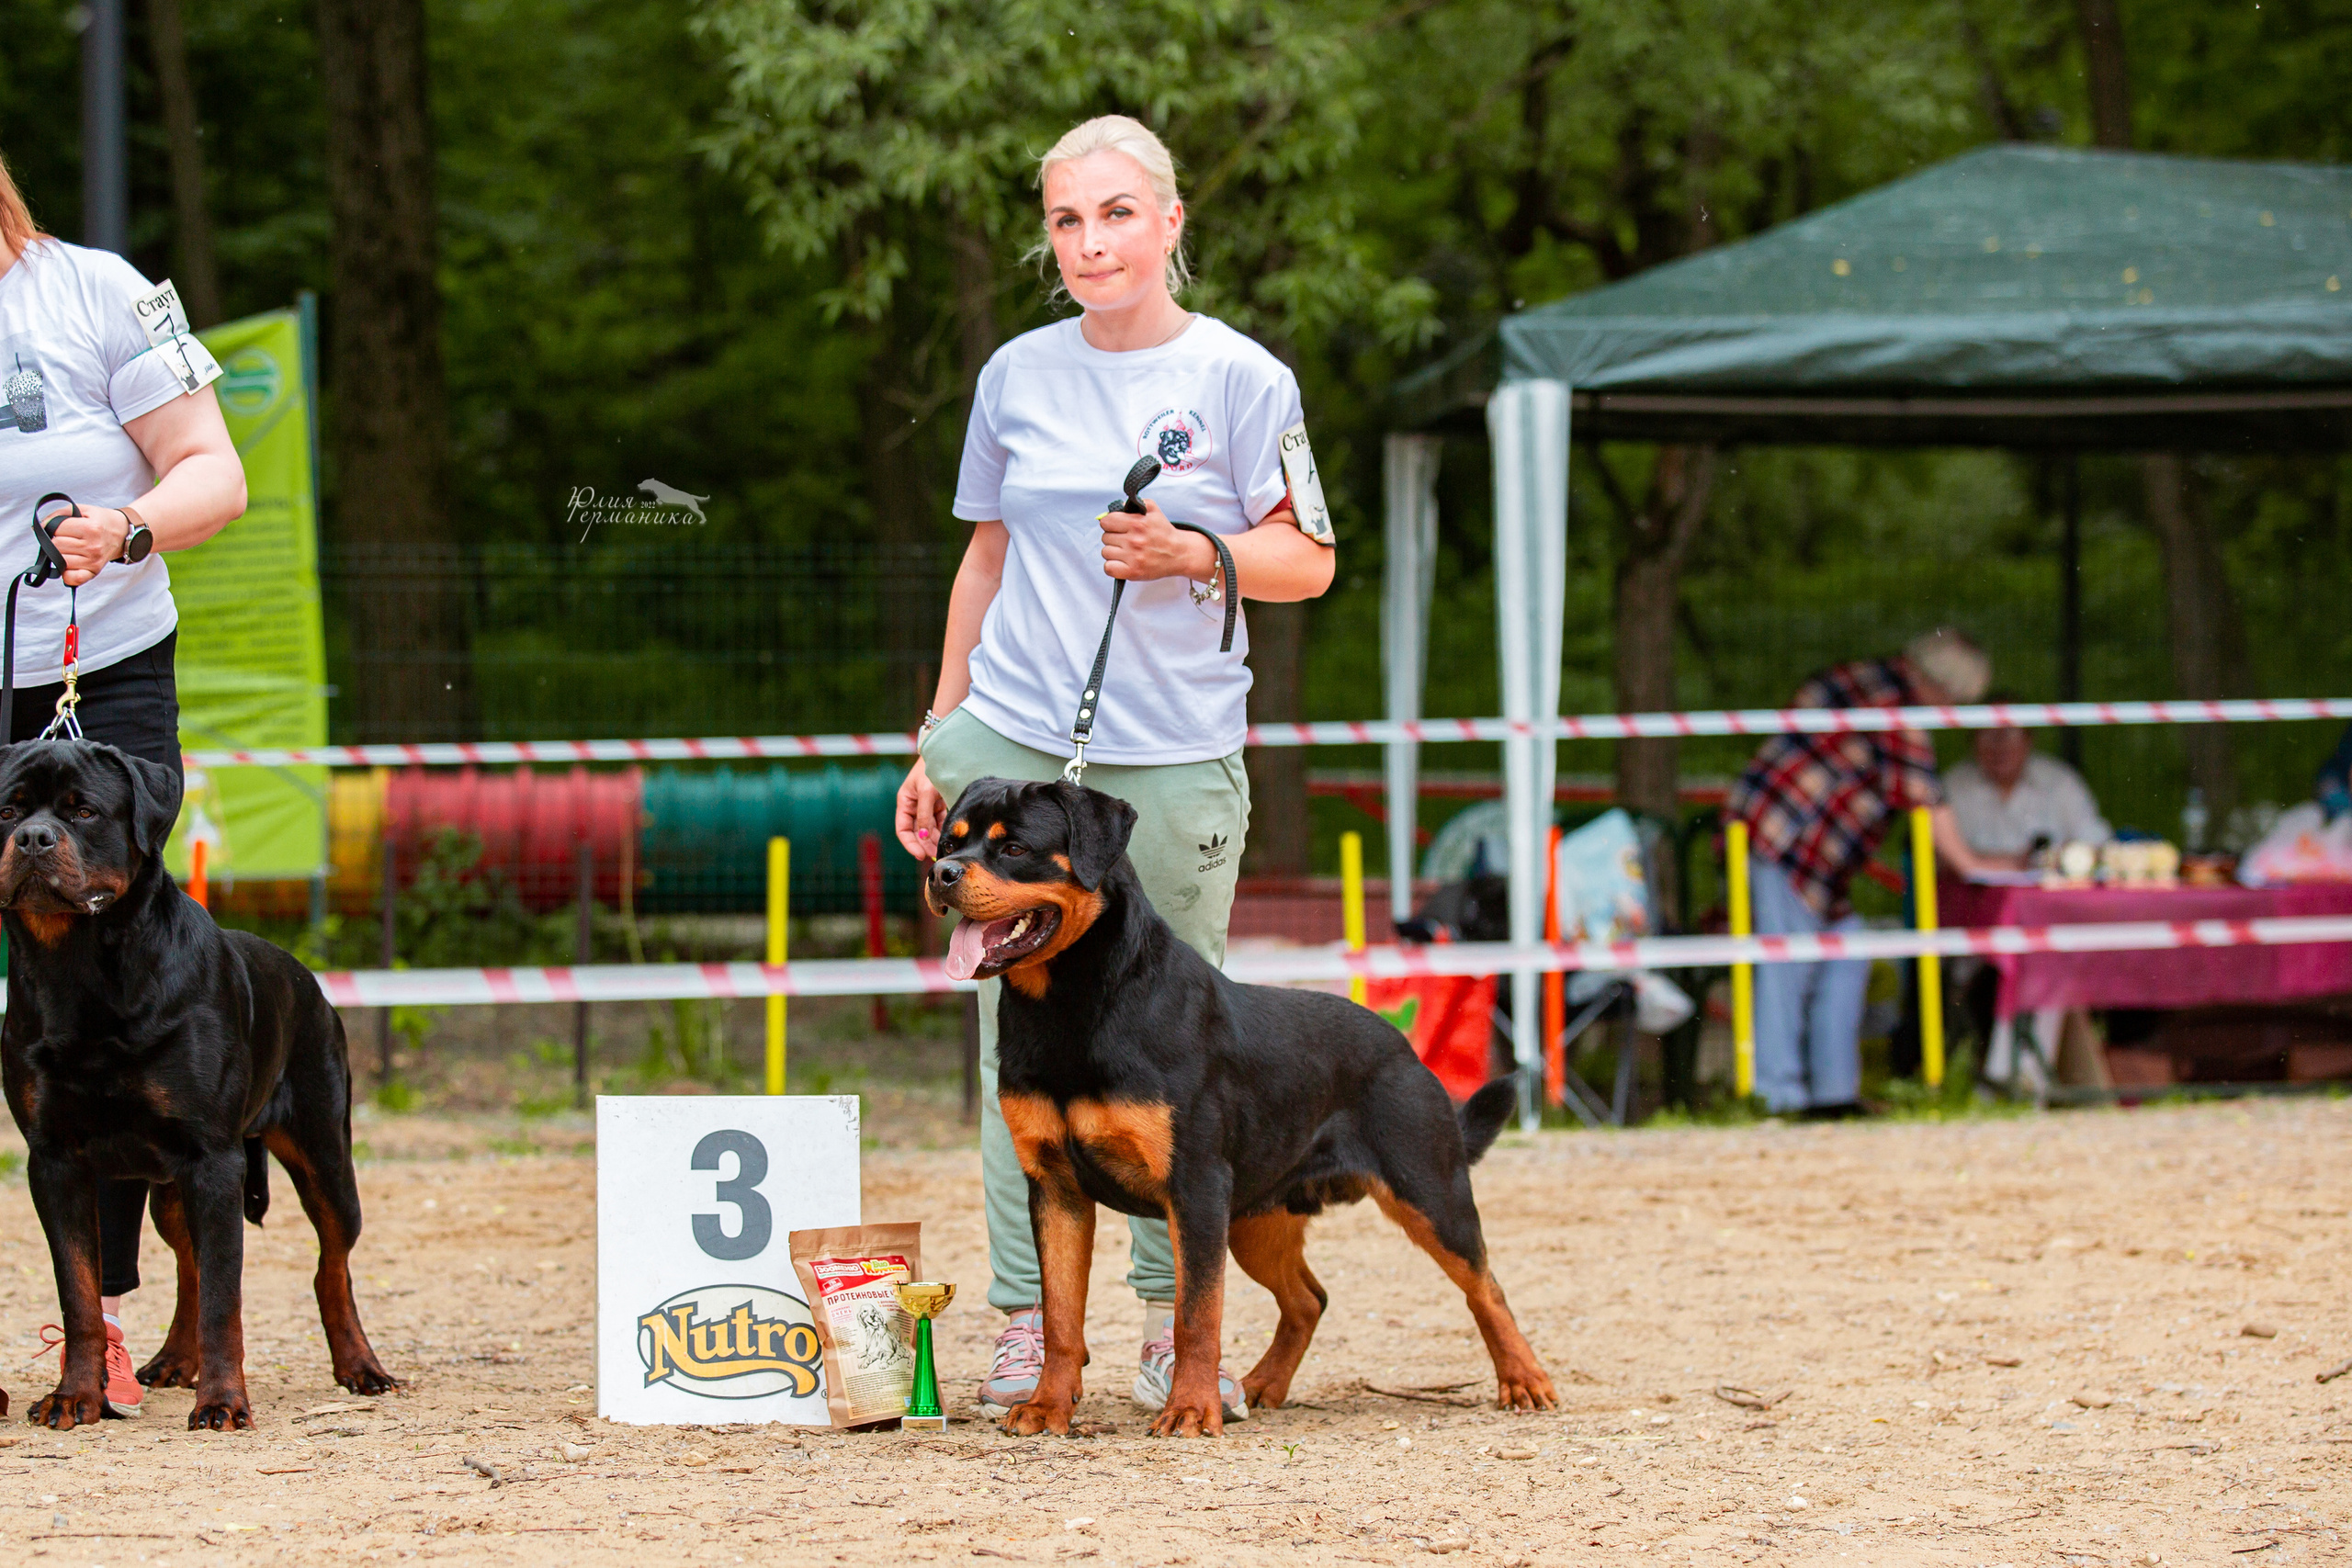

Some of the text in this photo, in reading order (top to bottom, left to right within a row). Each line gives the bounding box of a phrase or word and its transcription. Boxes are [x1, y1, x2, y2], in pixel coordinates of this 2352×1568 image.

[137, 288, 175, 318] Стаут
[1143, 409, 1206, 439] ROTTWEILER KENNEL
[1198, 856, 1227, 873] adidas
[691, 1129, 773, 1260] 3
[827, 1290, 889, 1306] ПРОТЕИНОВЫЕ
[638, 1300, 820, 1396] Nutro
